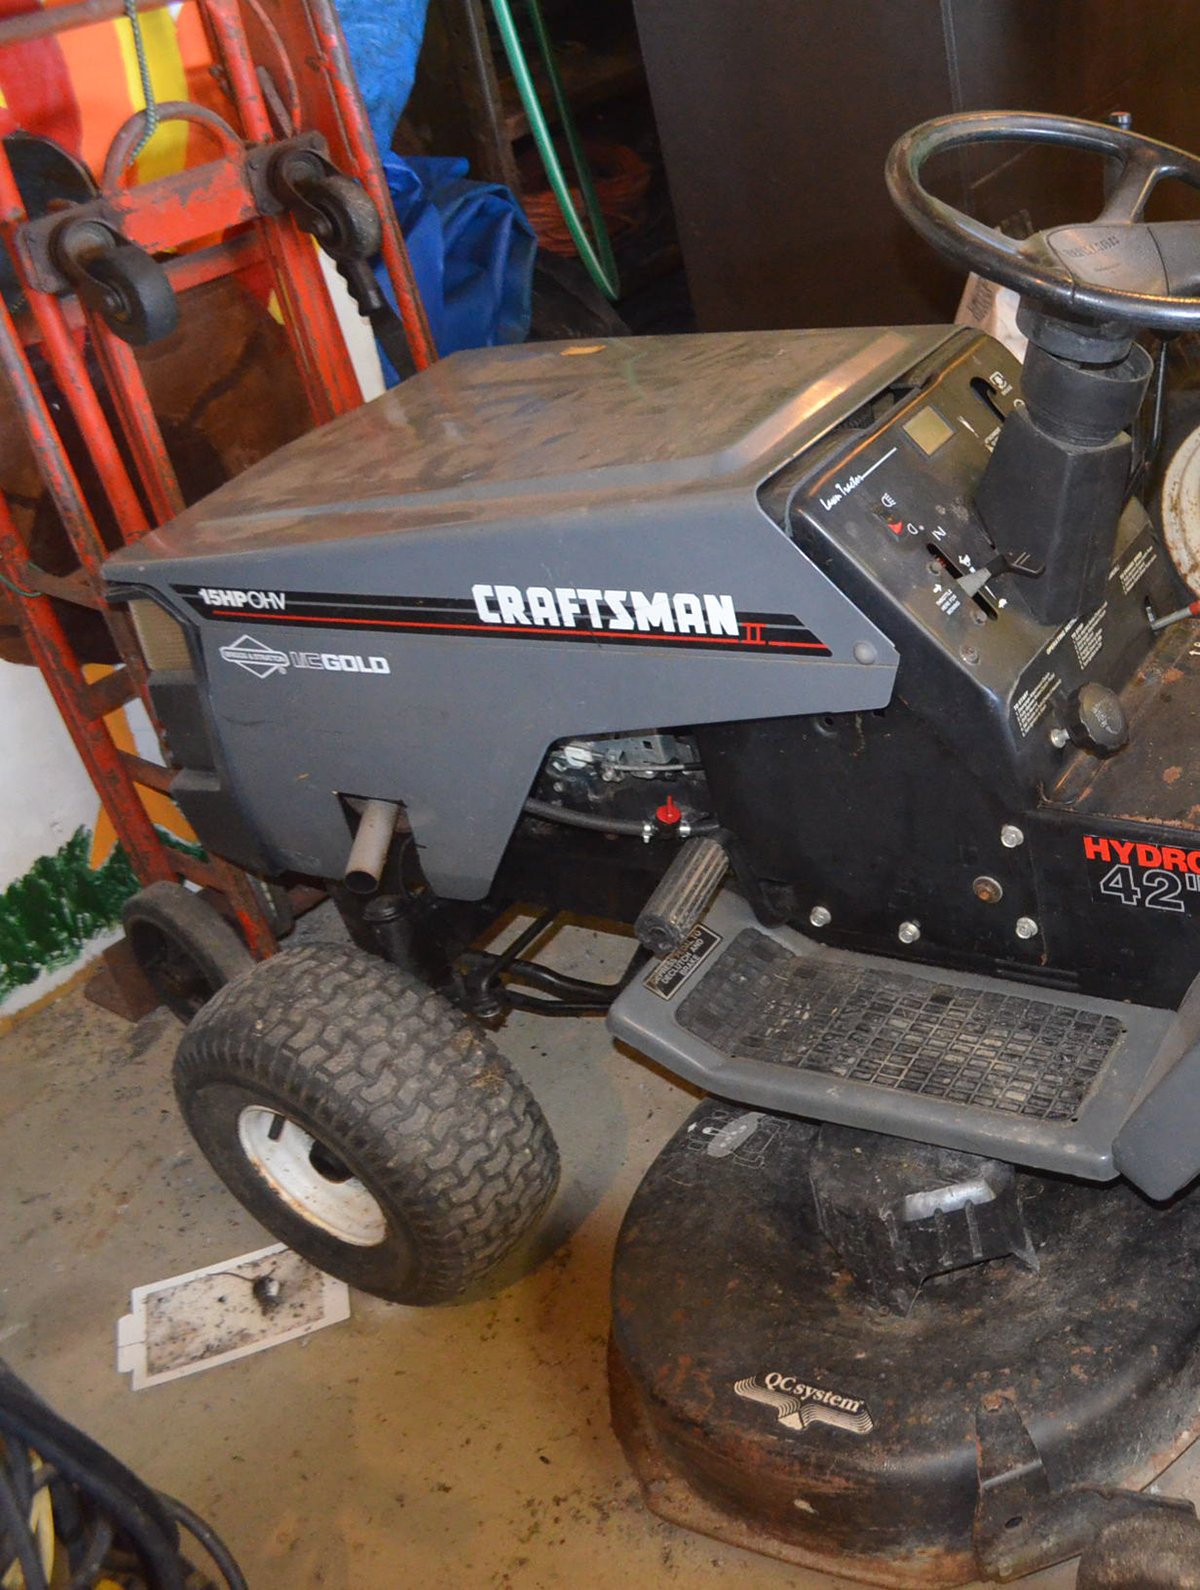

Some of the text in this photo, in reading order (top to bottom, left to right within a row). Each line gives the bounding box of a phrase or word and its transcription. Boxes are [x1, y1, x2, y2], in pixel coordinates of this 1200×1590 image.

[471, 584, 740, 637] CRAFTSMAN
[321, 653, 392, 675] GOLD
[690, 938, 704, 952] AND
